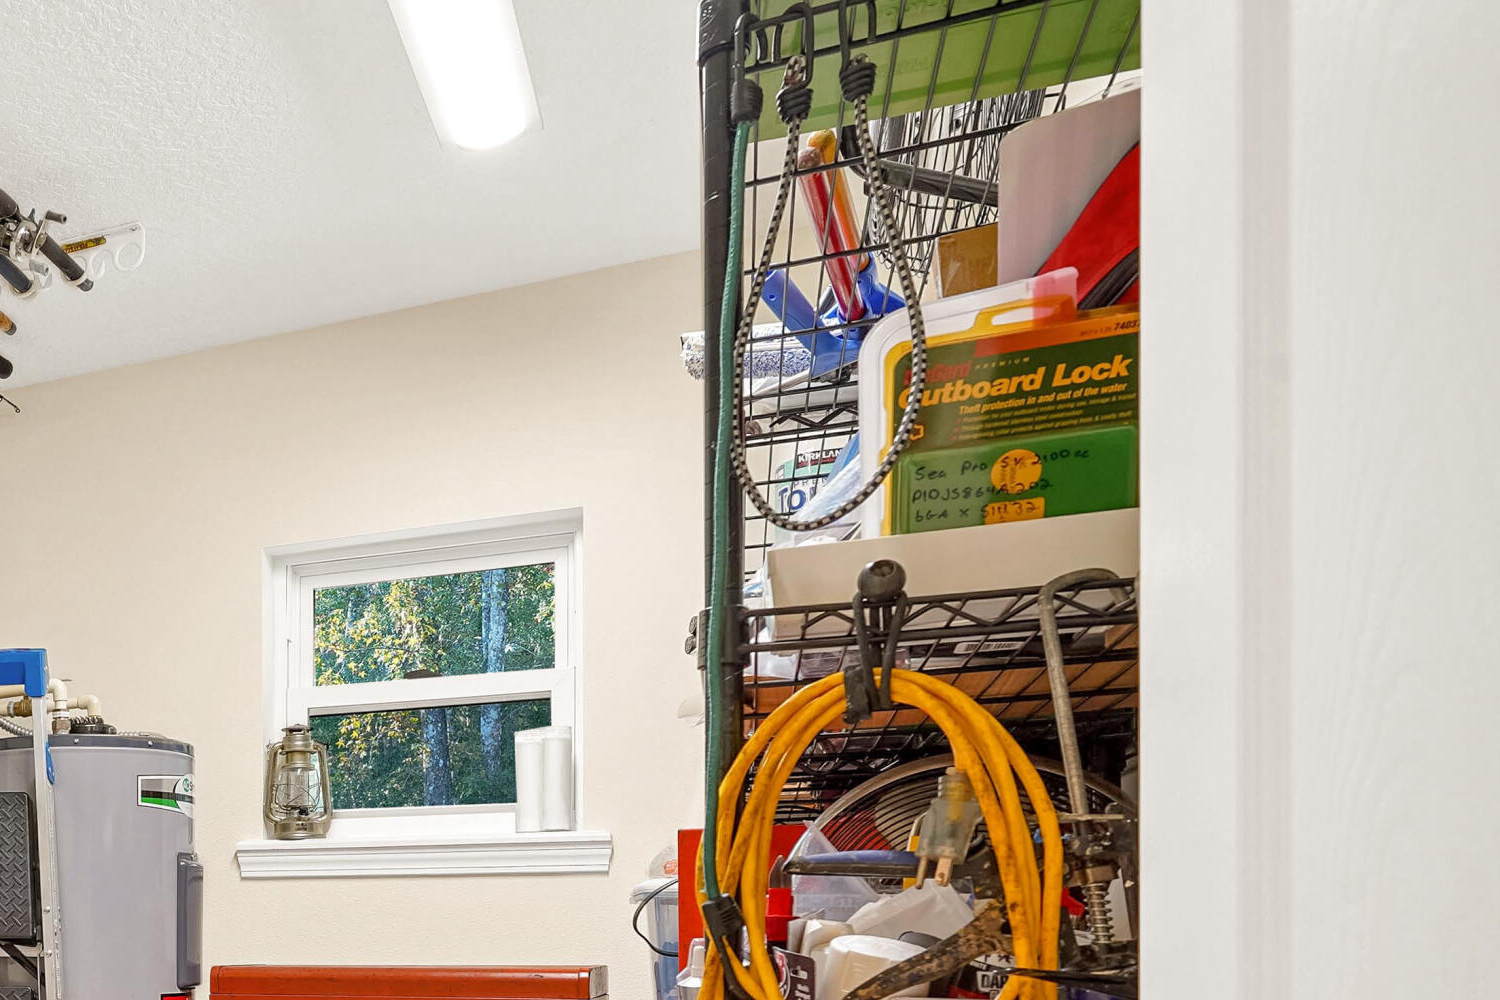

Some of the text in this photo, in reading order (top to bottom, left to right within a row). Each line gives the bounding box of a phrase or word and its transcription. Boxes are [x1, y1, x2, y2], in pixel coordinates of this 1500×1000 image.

[898, 366, 1047, 411] Outboard
[1052, 353, 1134, 387] Lock
[959, 402, 981, 416] Theft
[981, 397, 1026, 414] protection
[1026, 395, 1036, 406] in
[1037, 391, 1055, 404] and
[1056, 389, 1072, 401] out
[1073, 387, 1083, 398] of
[1083, 385, 1099, 397] the
[1100, 381, 1128, 395] water
[914, 466, 948, 481] Sea
[960, 460, 988, 476] Pro
